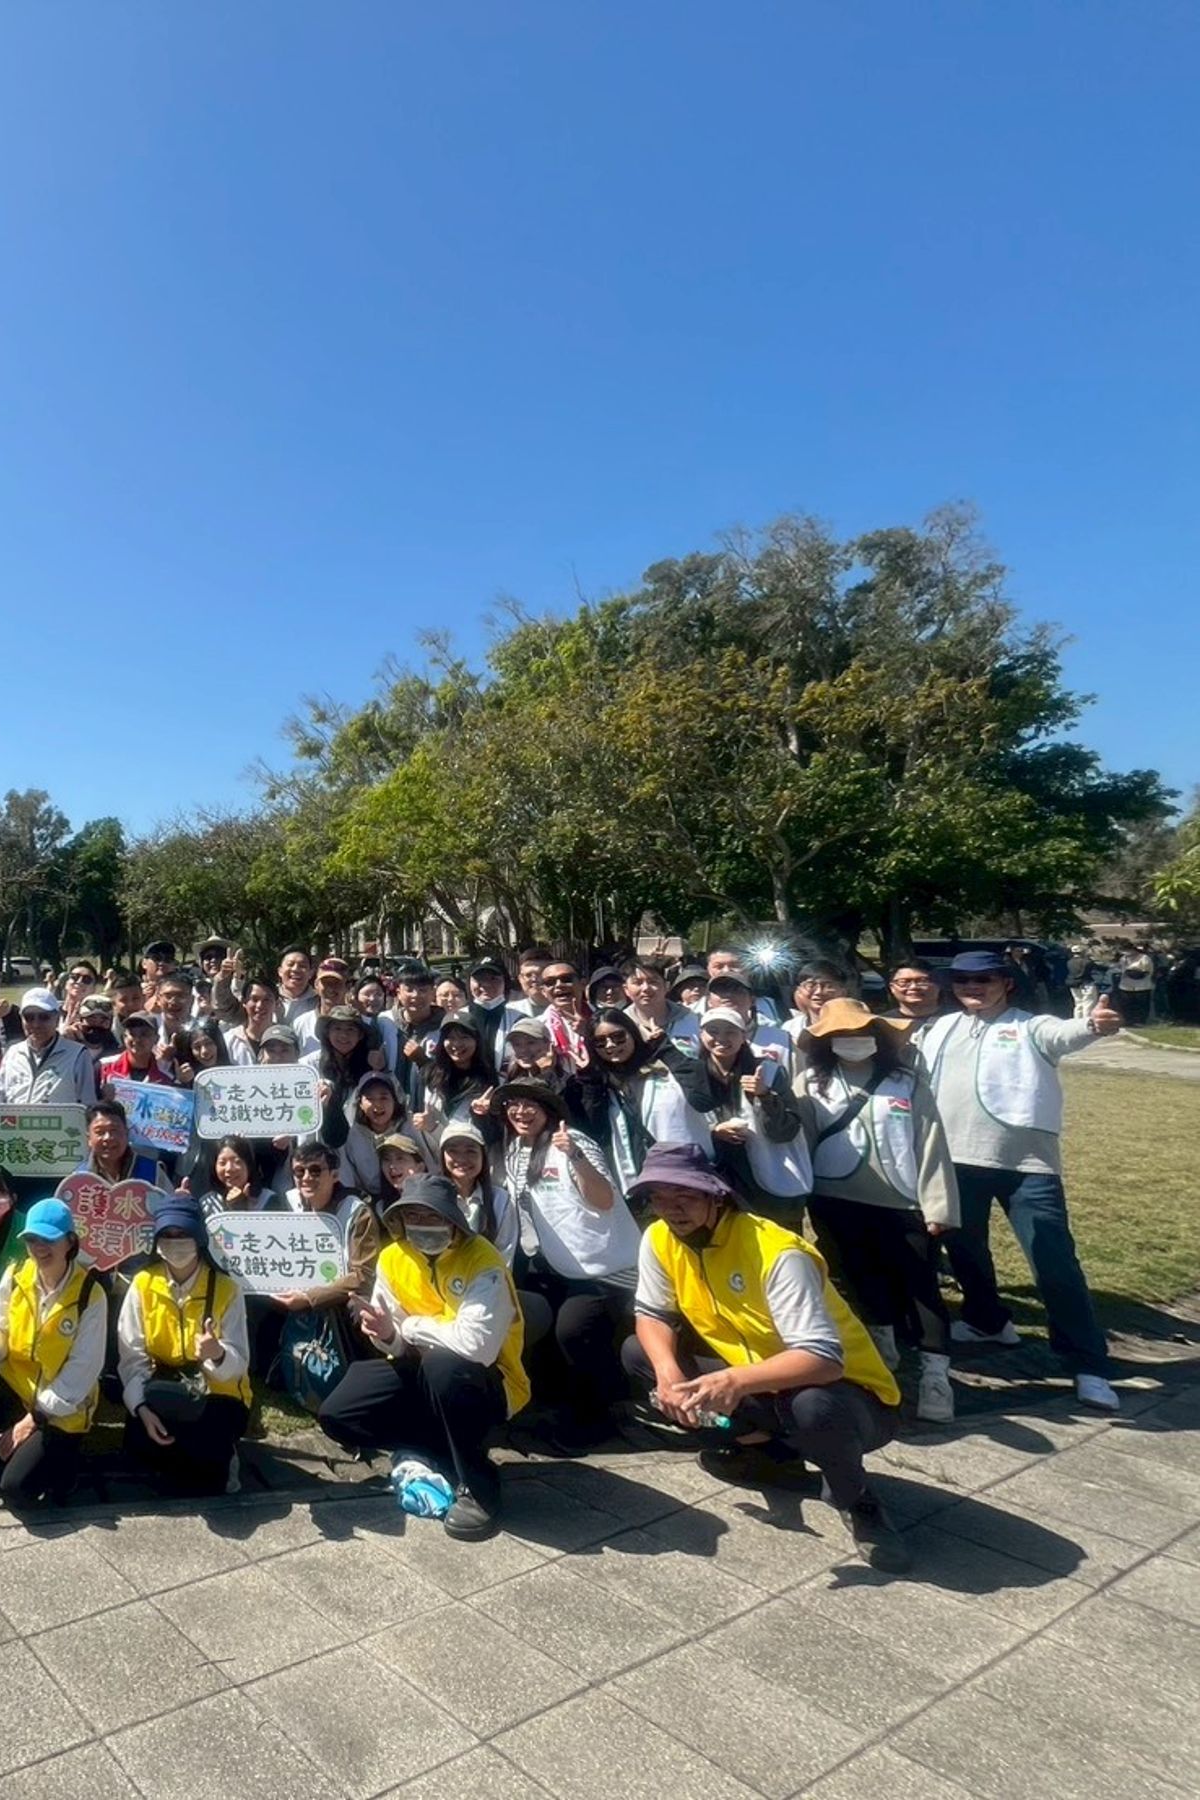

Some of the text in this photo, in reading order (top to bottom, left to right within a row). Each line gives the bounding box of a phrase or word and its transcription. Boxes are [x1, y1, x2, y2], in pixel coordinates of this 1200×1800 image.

[227, 1081, 313, 1102] 走入社區
[209, 1103, 295, 1123] 認識地方
[78, 1185, 146, 1220] 護水
[240, 1232, 337, 1254] 走入社區
[220, 1256, 317, 1279] 認識地方
